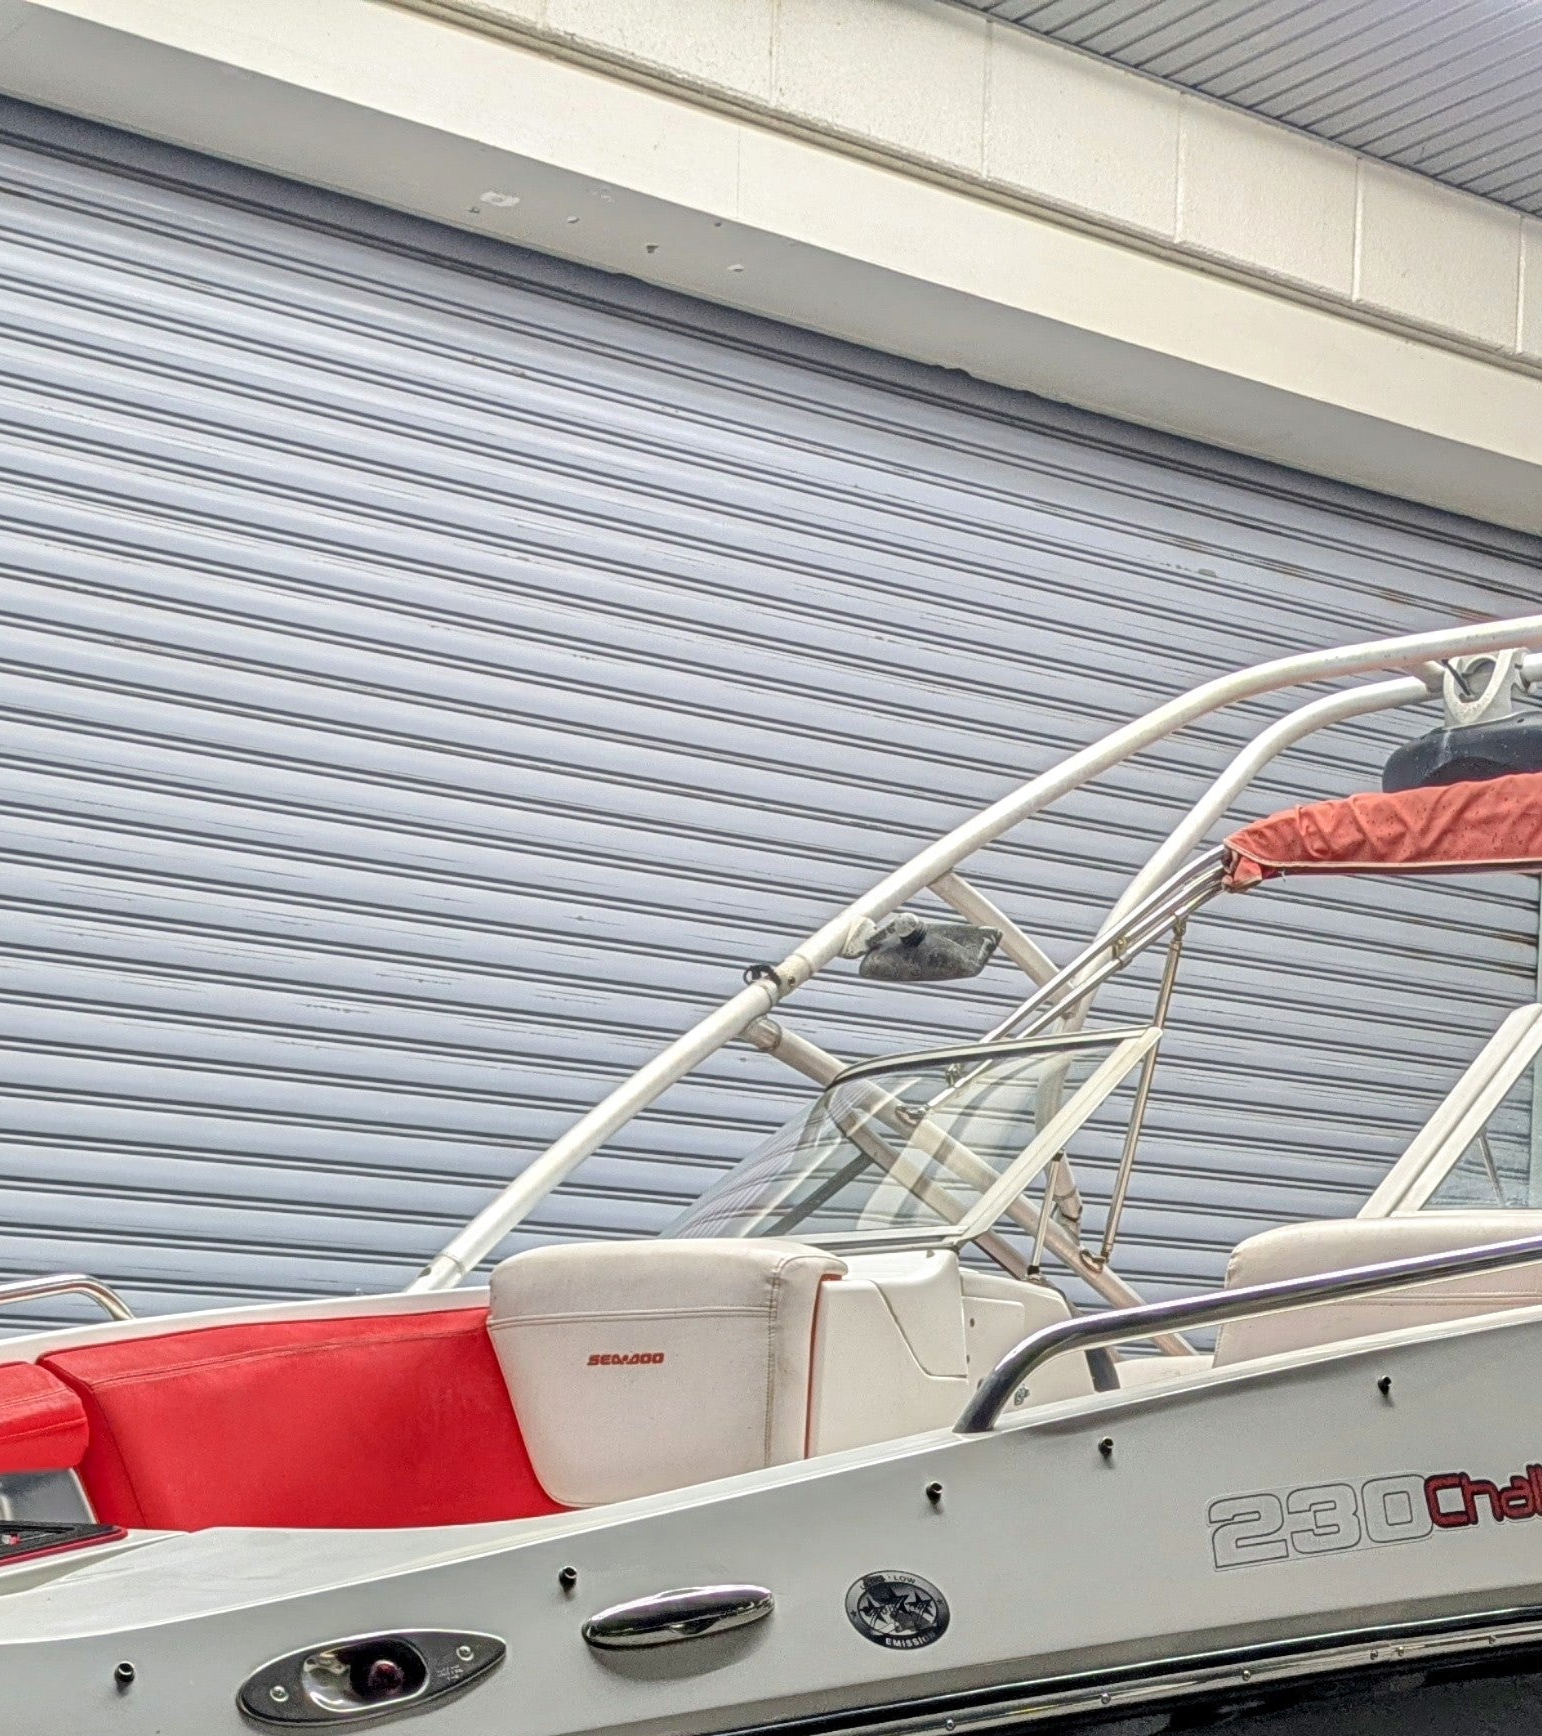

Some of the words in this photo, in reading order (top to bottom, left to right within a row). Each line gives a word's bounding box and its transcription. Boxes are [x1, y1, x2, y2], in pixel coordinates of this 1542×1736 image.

[1208, 1473, 1434, 1569] 230
[892, 1574, 917, 1584] LOW
[885, 1631, 937, 1649] EMISSION
